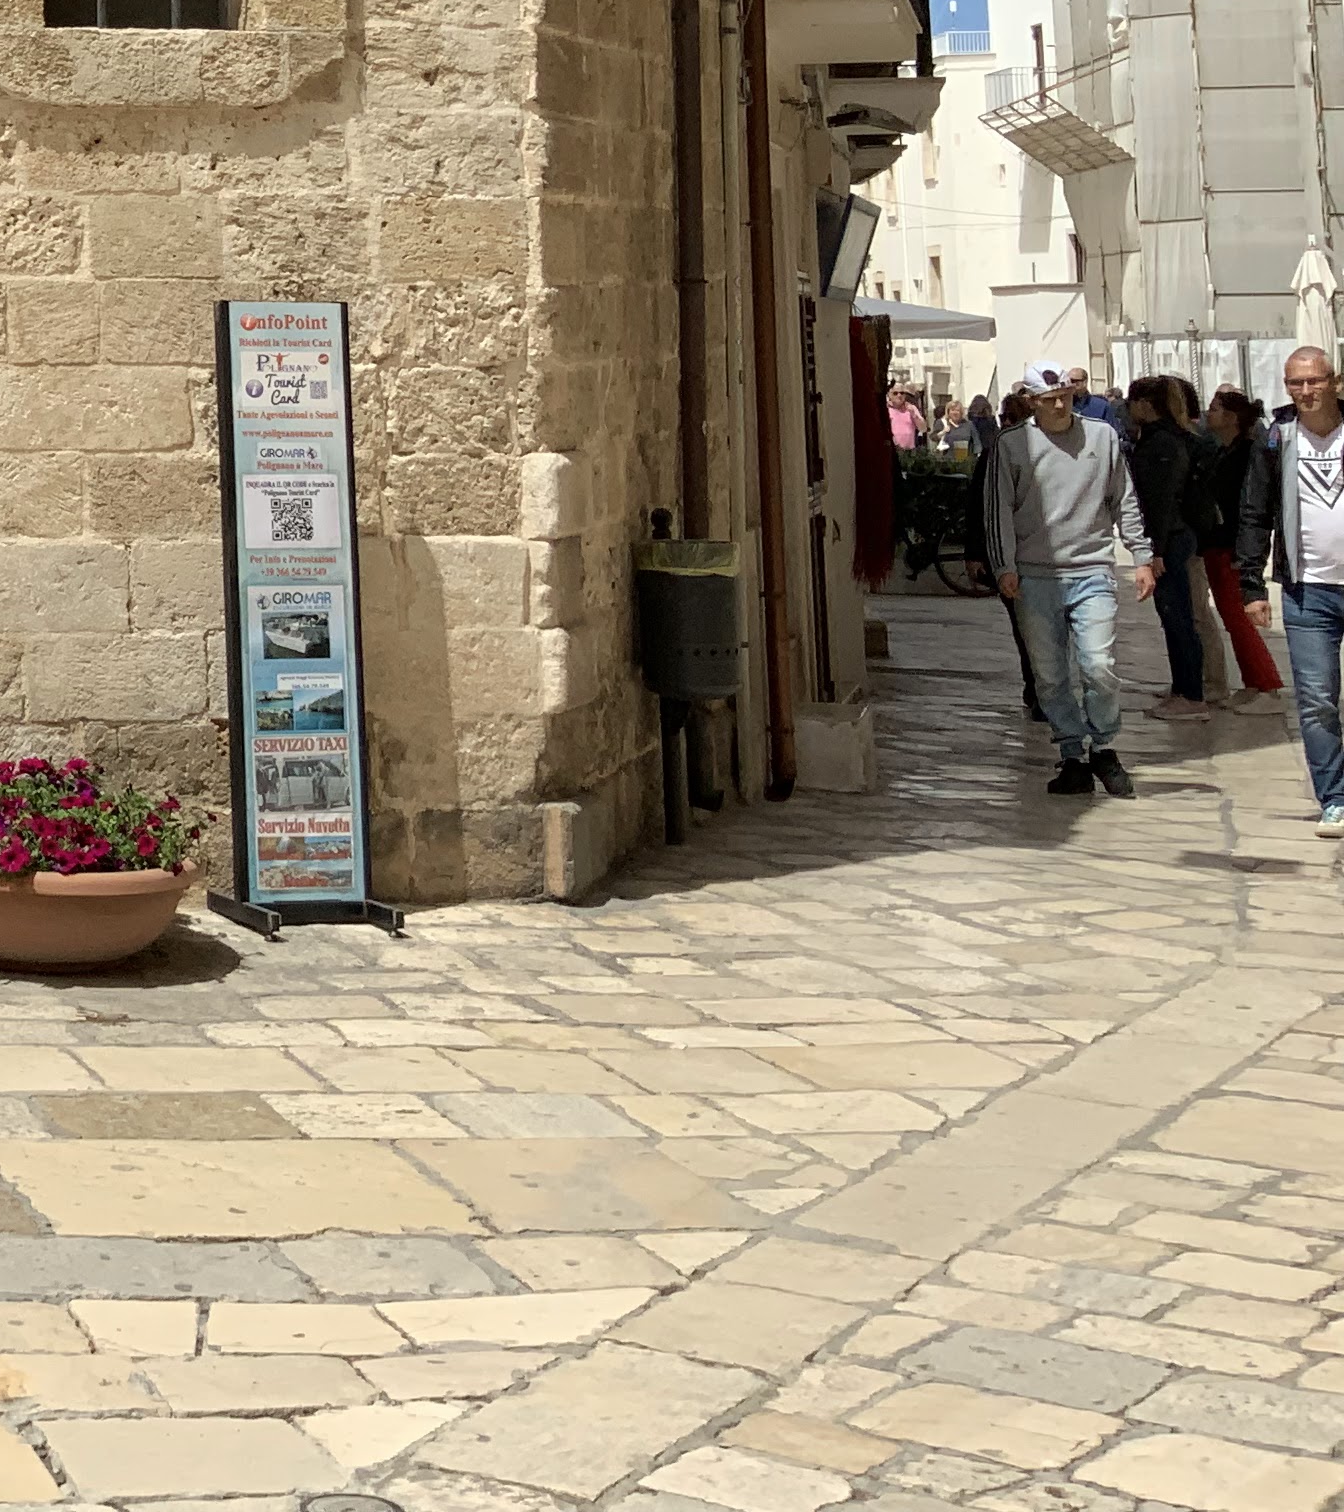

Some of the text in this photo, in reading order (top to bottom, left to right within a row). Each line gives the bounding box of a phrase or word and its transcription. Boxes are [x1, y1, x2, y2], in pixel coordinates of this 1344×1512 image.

[283, 338, 310, 347] Tourist
[312, 338, 332, 347] Card
[265, 373, 307, 388] Tourist
[271, 389, 300, 405] Card
[260, 448, 305, 458] GIROMAR
[257, 461, 294, 470] Polignano
[303, 461, 323, 469] Mare
[250, 555, 262, 563] Per
[273, 592, 331, 604] GIROMAR
[254, 737, 347, 752] SERVIZIO TAXI
[258, 818, 350, 833] Servizio Navetta
